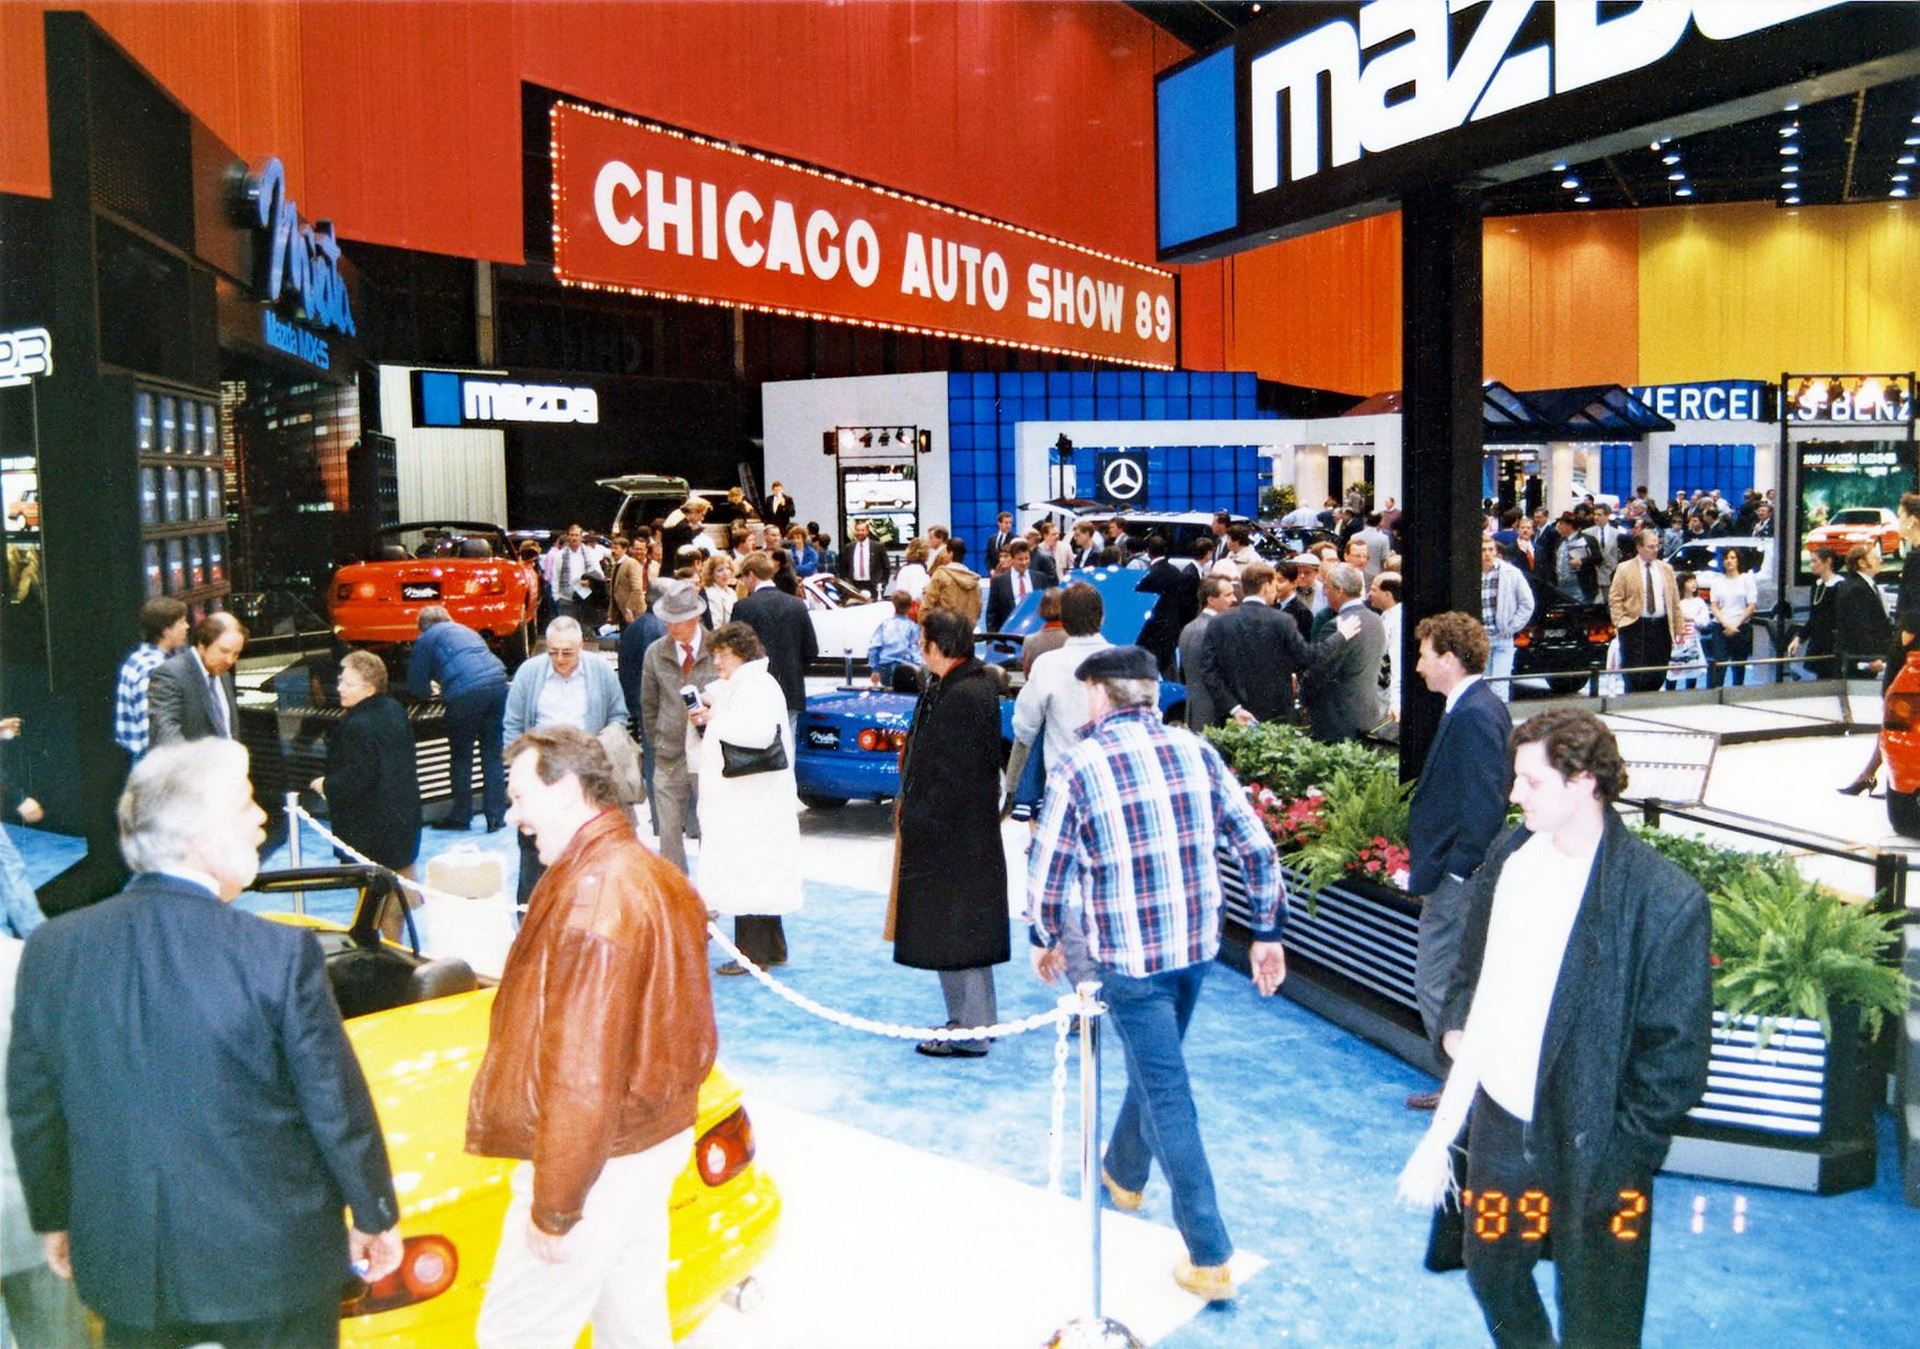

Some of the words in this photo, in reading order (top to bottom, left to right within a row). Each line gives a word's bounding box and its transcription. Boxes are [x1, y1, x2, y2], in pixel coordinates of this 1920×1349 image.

[1252, 0, 1850, 194] mazd
[593, 160, 880, 288] CHICAGO
[901, 232, 1008, 311] AUTO
[1027, 263, 1124, 334] SHOW
[1135, 291, 1171, 343] 89
